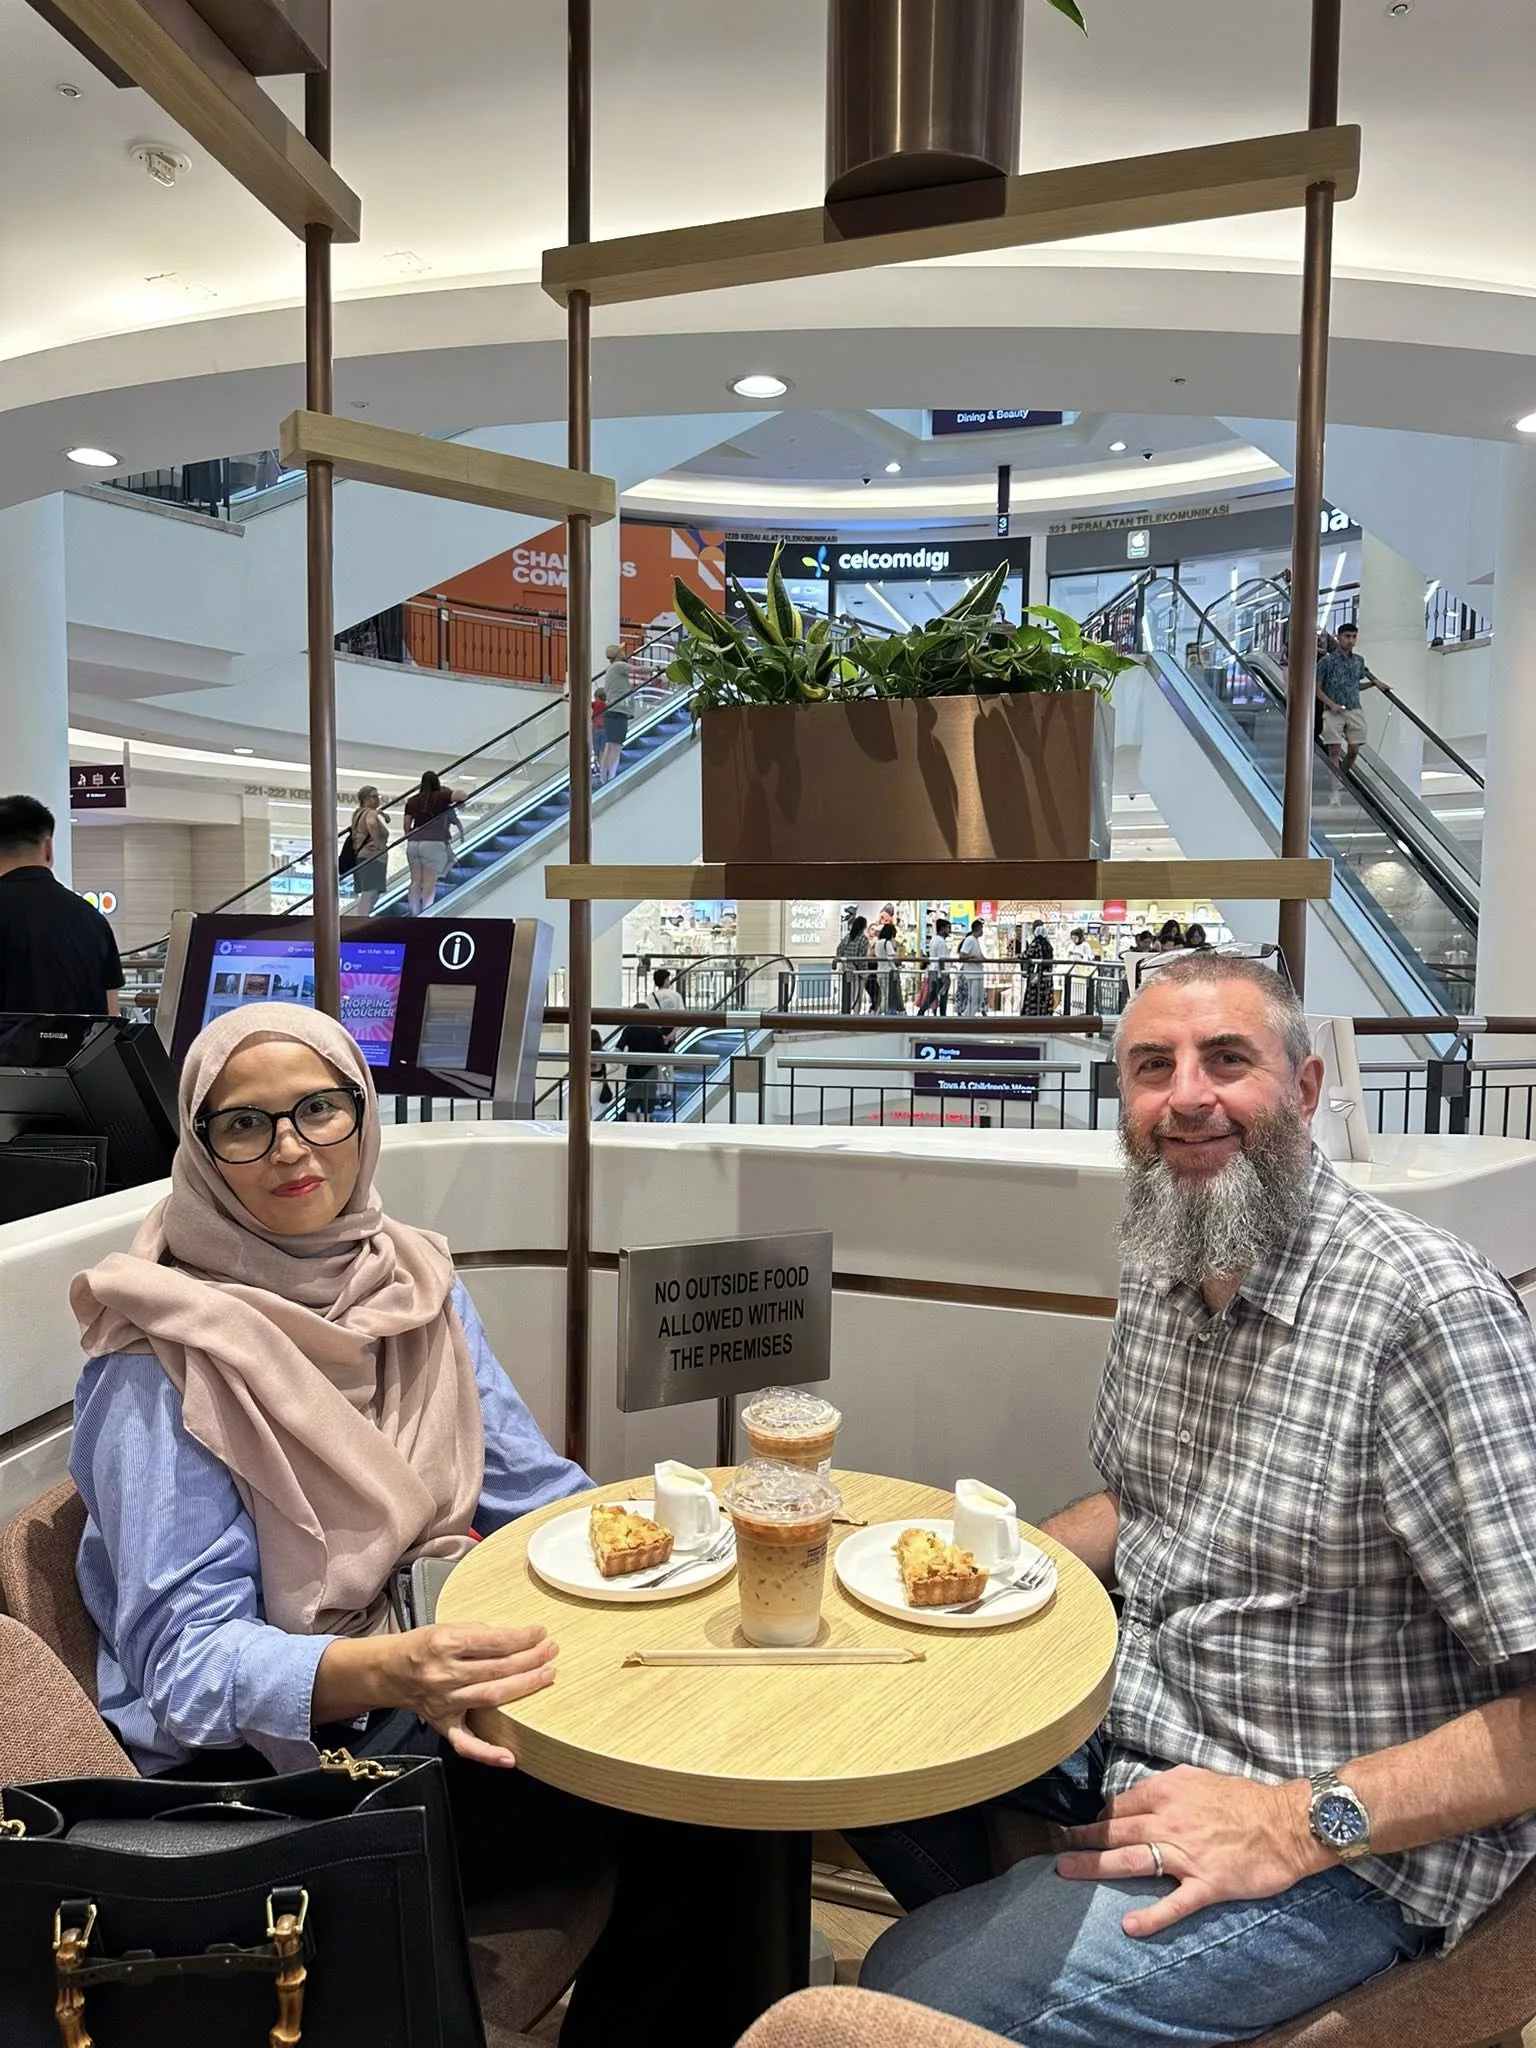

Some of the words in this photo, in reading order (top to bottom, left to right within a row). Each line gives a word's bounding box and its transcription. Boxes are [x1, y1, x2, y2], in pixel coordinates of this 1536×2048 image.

[957, 413, 986, 423] Dining
[987, 411, 995, 420] &
[997, 409, 1029, 419] Beauty
[999, 517, 1008, 528] 3
[1049, 526, 1066, 534] 323
[1071, 518, 1134, 532] PERALATAN
[1136, 504, 1230, 525] TELEKOMUNIKASI
[838, 548, 949, 571] celcomdigi
[244, 786, 287, 797] 221-222
[40, 1031, 68, 1039] TOSHIBA
[920, 1046, 936, 1061] 2
[655, 1280, 680, 1304] NO
[686, 1271, 759, 1300] OUTSIDE
[765, 1265, 809, 1291] FOOD
[658, 1306, 743, 1339] ALLOWED
[748, 1299, 805, 1326] WITHIN
[671, 1345, 704, 1371] THE
[709, 1333, 793, 1366] PREMISES
